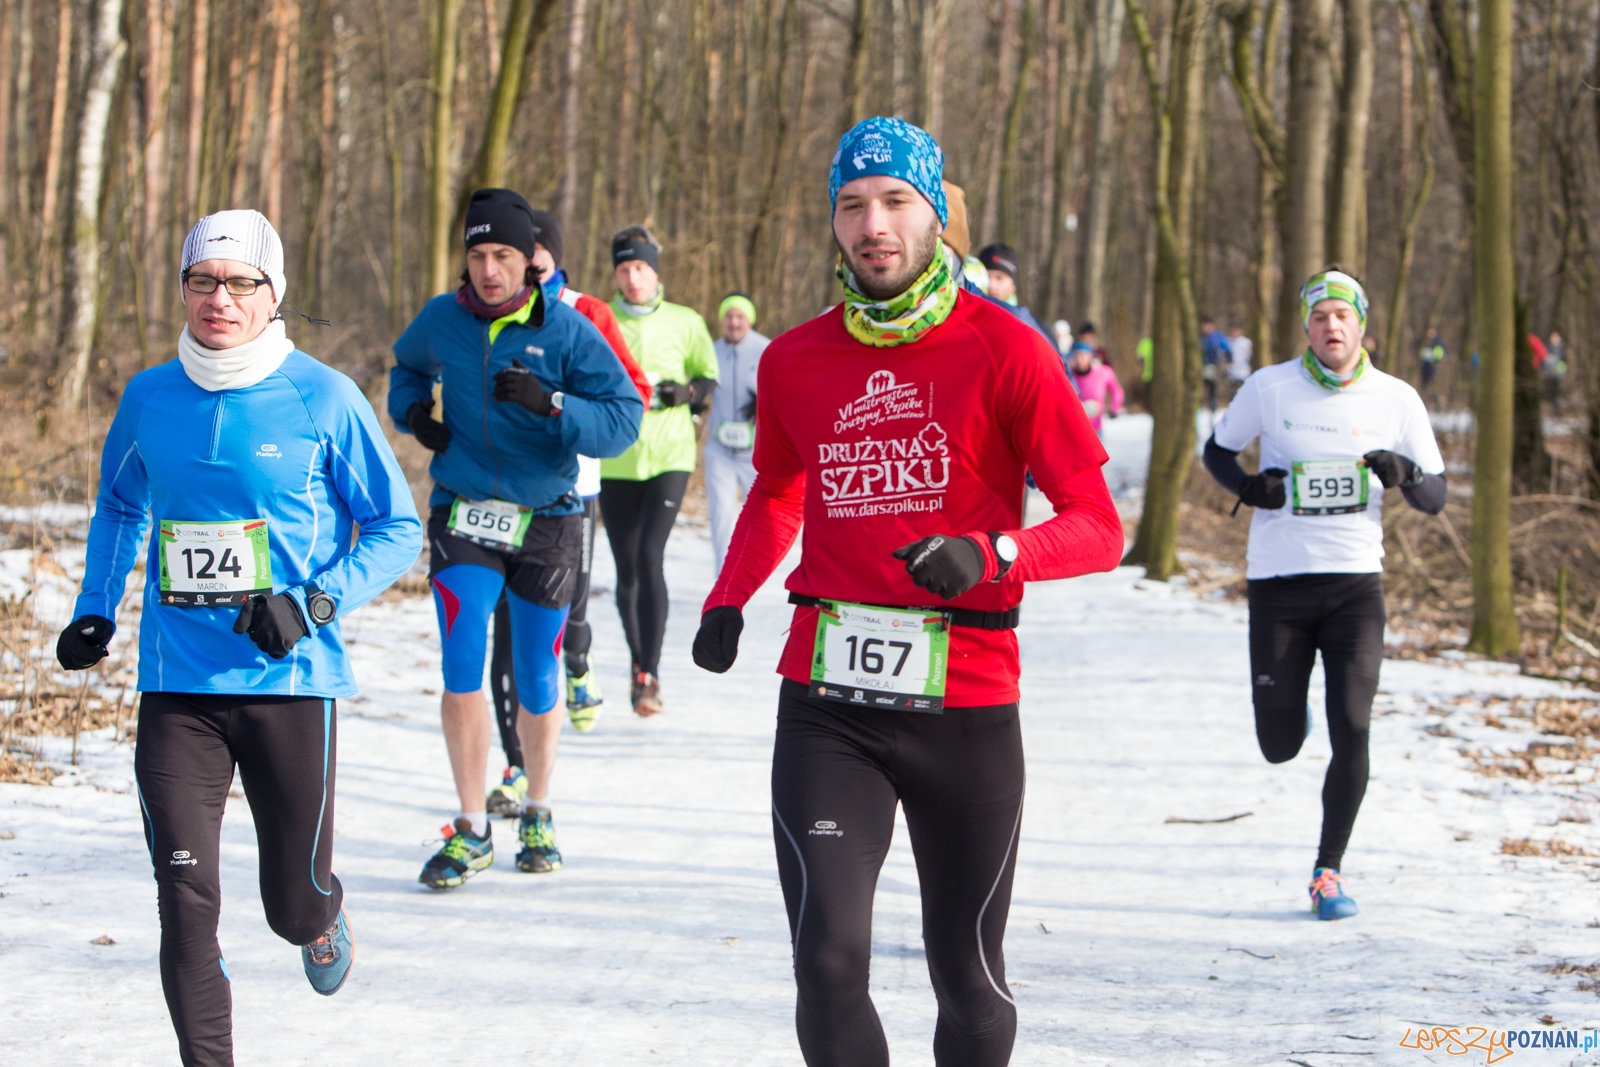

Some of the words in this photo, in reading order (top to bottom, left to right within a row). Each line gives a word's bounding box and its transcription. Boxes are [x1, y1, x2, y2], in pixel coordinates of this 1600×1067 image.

[838, 402, 853, 421] VI
[884, 397, 924, 415] Szpiku
[818, 435, 925, 464] DRUŻYNA
[820, 457, 952, 501] SZPIKU
[1309, 477, 1354, 498] 593
[827, 496, 943, 518] www.darszpiku.pl
[466, 508, 513, 532] 656
[181, 548, 242, 579] 124
[196, 582, 228, 590] MARCIN
[845, 635, 913, 677] 167
[931, 652, 943, 686] Poznań
[854, 676, 895, 690] MIKOŁAJ
